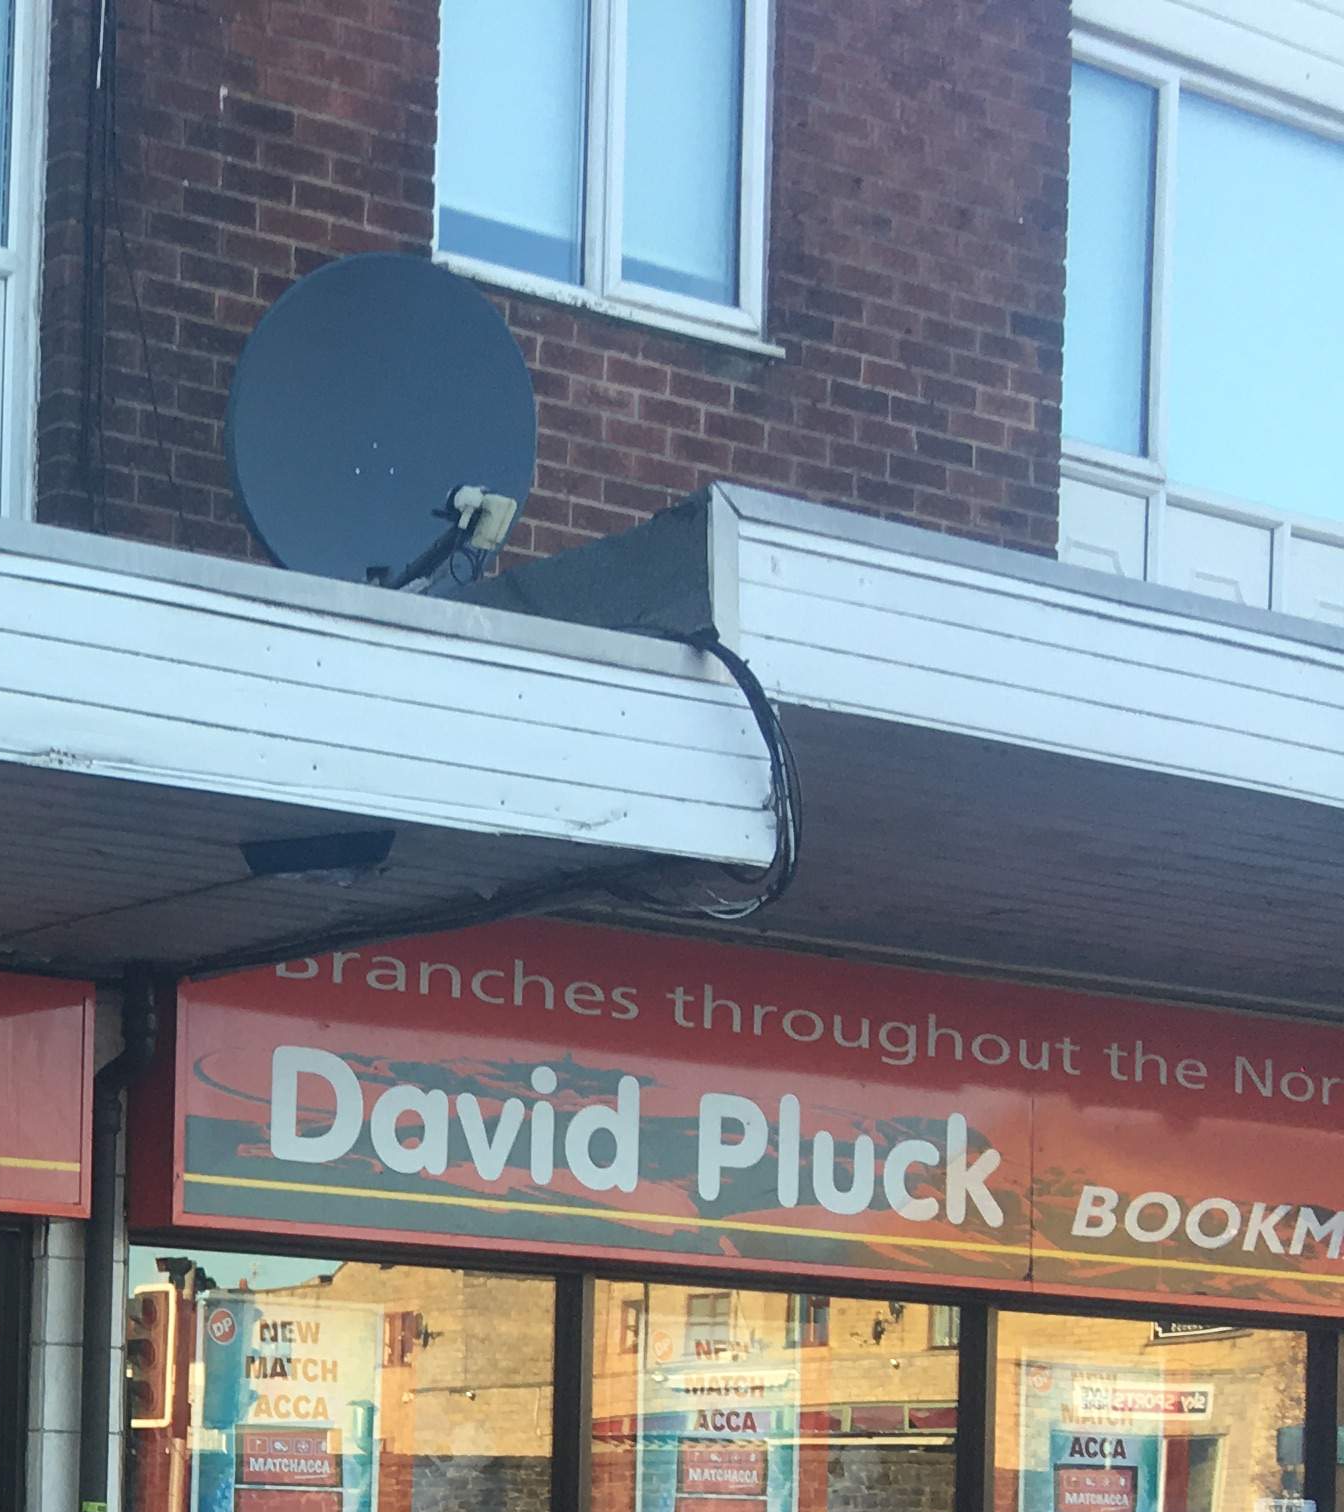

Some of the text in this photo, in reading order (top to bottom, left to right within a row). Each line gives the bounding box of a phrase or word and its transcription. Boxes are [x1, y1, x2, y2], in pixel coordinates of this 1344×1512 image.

[666, 984, 1080, 1075] throughout
[1104, 1040, 1208, 1089] the
[271, 1045, 1004, 1228] David Pluck
[212, 1316, 232, 1338] DP
[260, 1320, 320, 1344] NEW
[694, 1338, 750, 1361] NE
[246, 1356, 338, 1382] MATCH
[254, 1395, 330, 1420] ACCA
[694, 1409, 758, 1433] ACCA
[1069, 1437, 1127, 1459] ACCA
[250, 1456, 331, 1474] MATCHACCA
